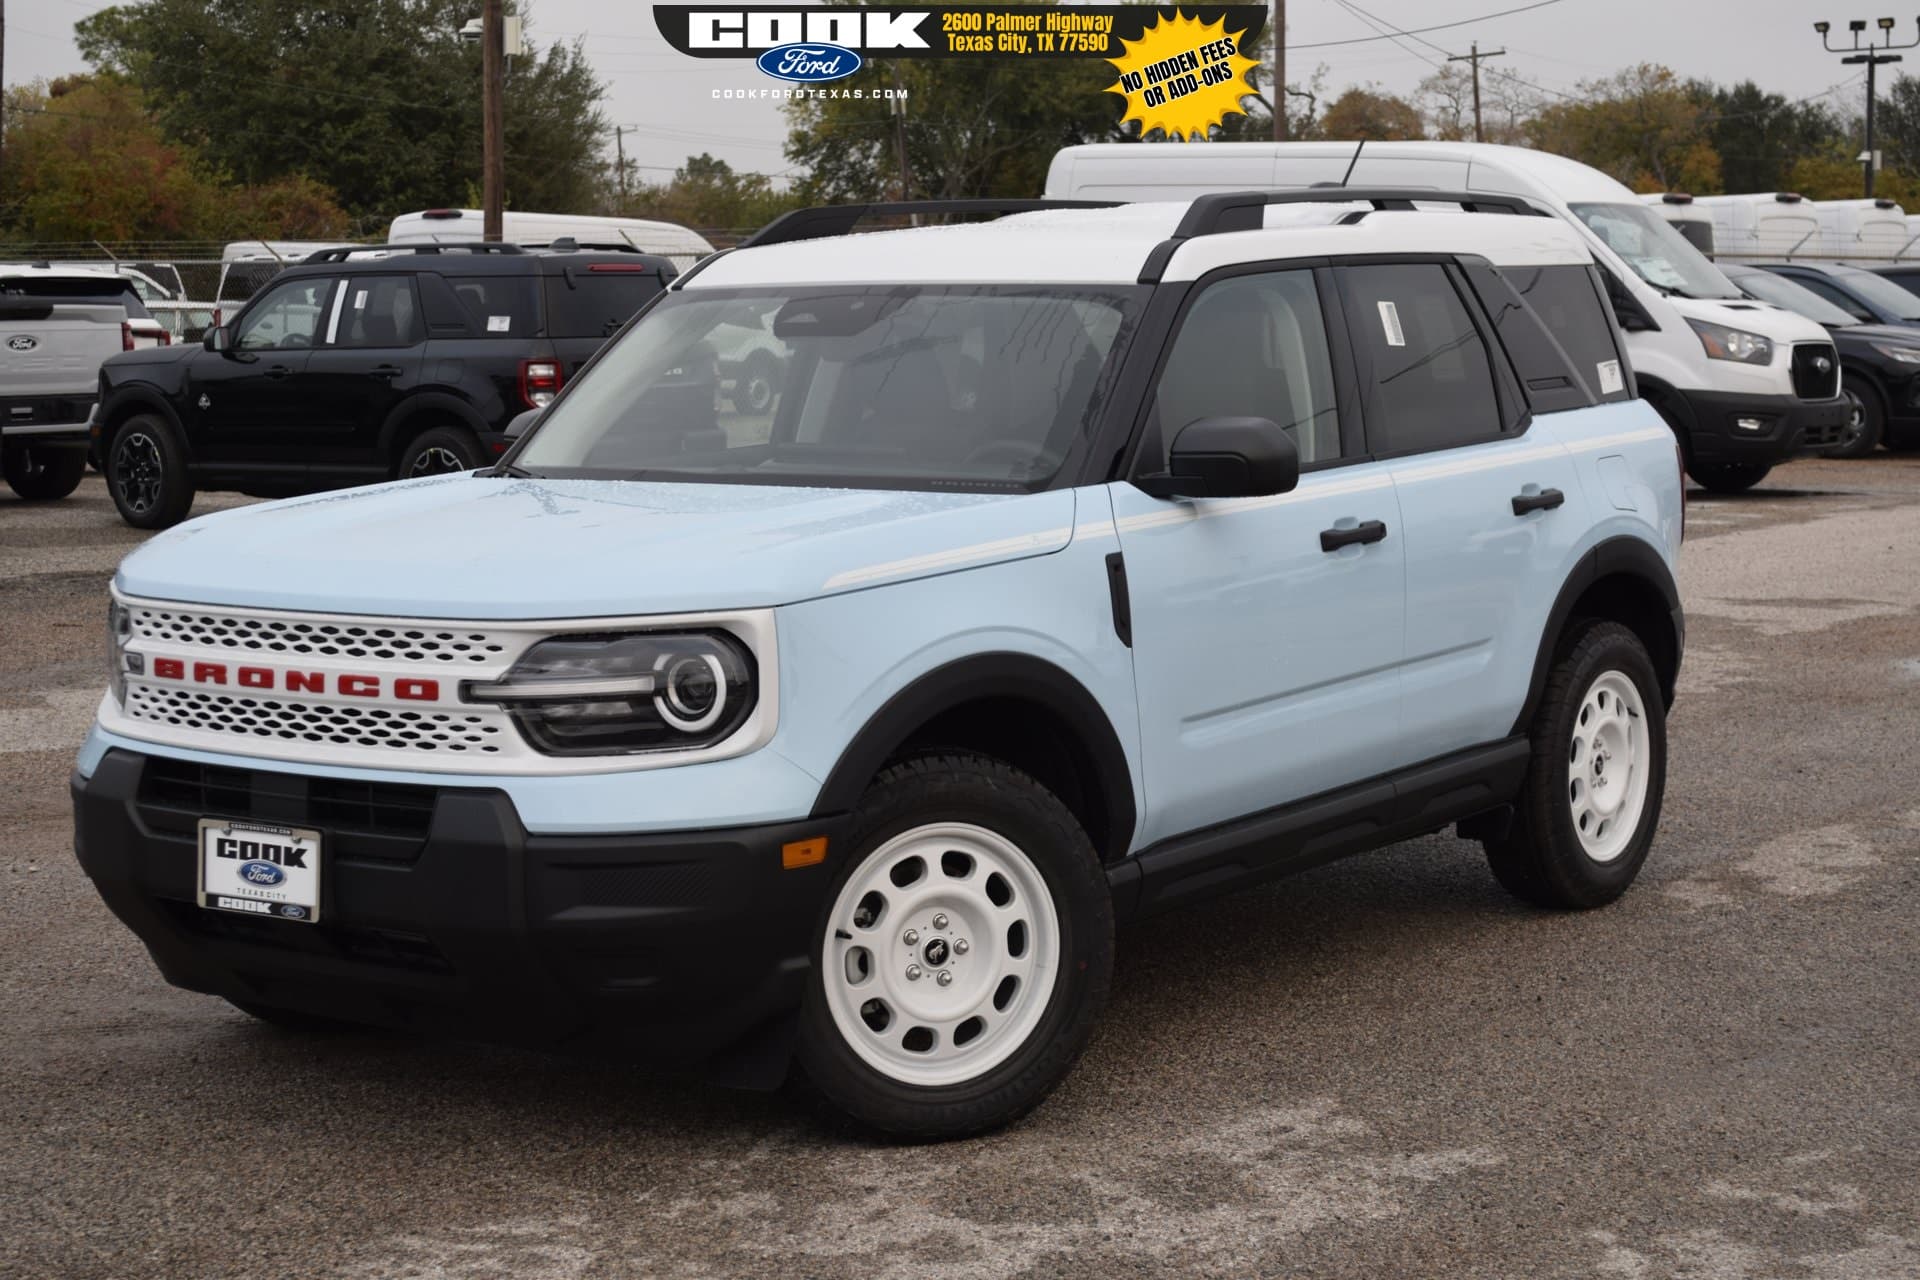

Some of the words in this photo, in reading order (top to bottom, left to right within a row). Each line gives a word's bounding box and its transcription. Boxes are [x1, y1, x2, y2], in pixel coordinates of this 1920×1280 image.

[154, 657, 439, 701] BRONCO
[217, 838, 307, 869] COOK
[248, 864, 276, 883] Ford
[218, 896, 272, 914] COOK
